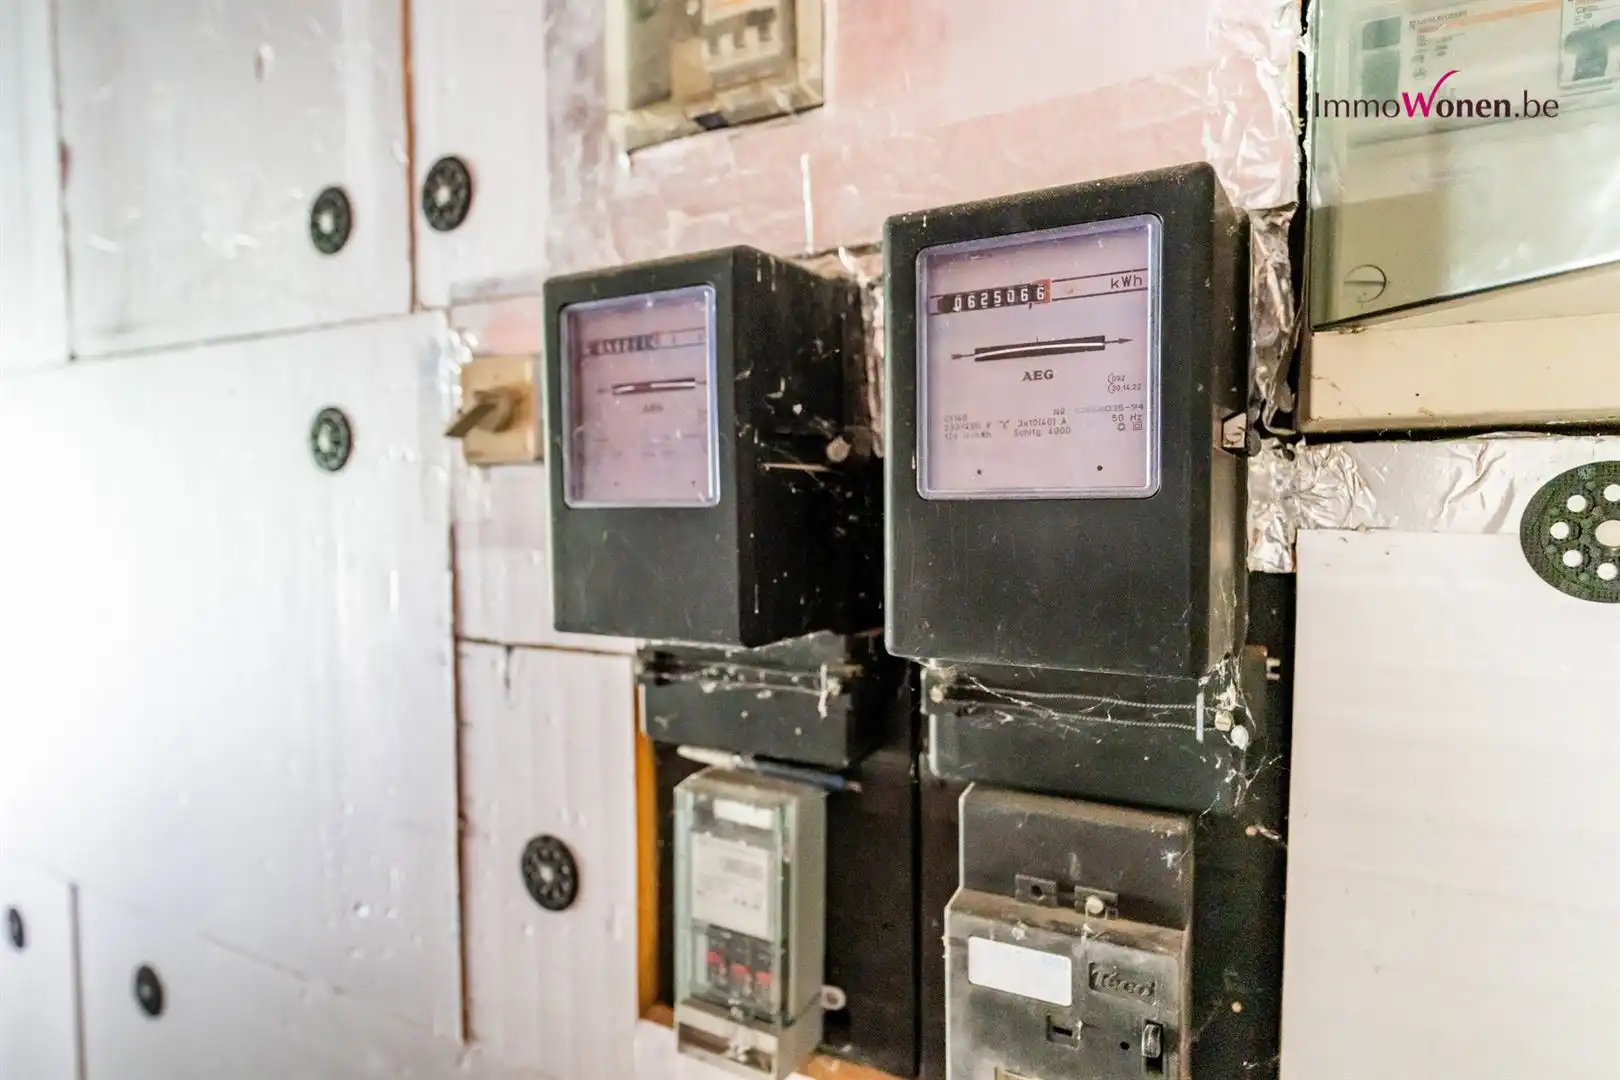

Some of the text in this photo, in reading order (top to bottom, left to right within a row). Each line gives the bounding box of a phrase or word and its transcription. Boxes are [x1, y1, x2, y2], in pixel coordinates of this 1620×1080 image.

[1110, 274, 1143, 289] kWh
[1022, 369, 1054, 381] AEG
[1061, 417, 1067, 426] A
[1130, 412, 1143, 422] Hz
